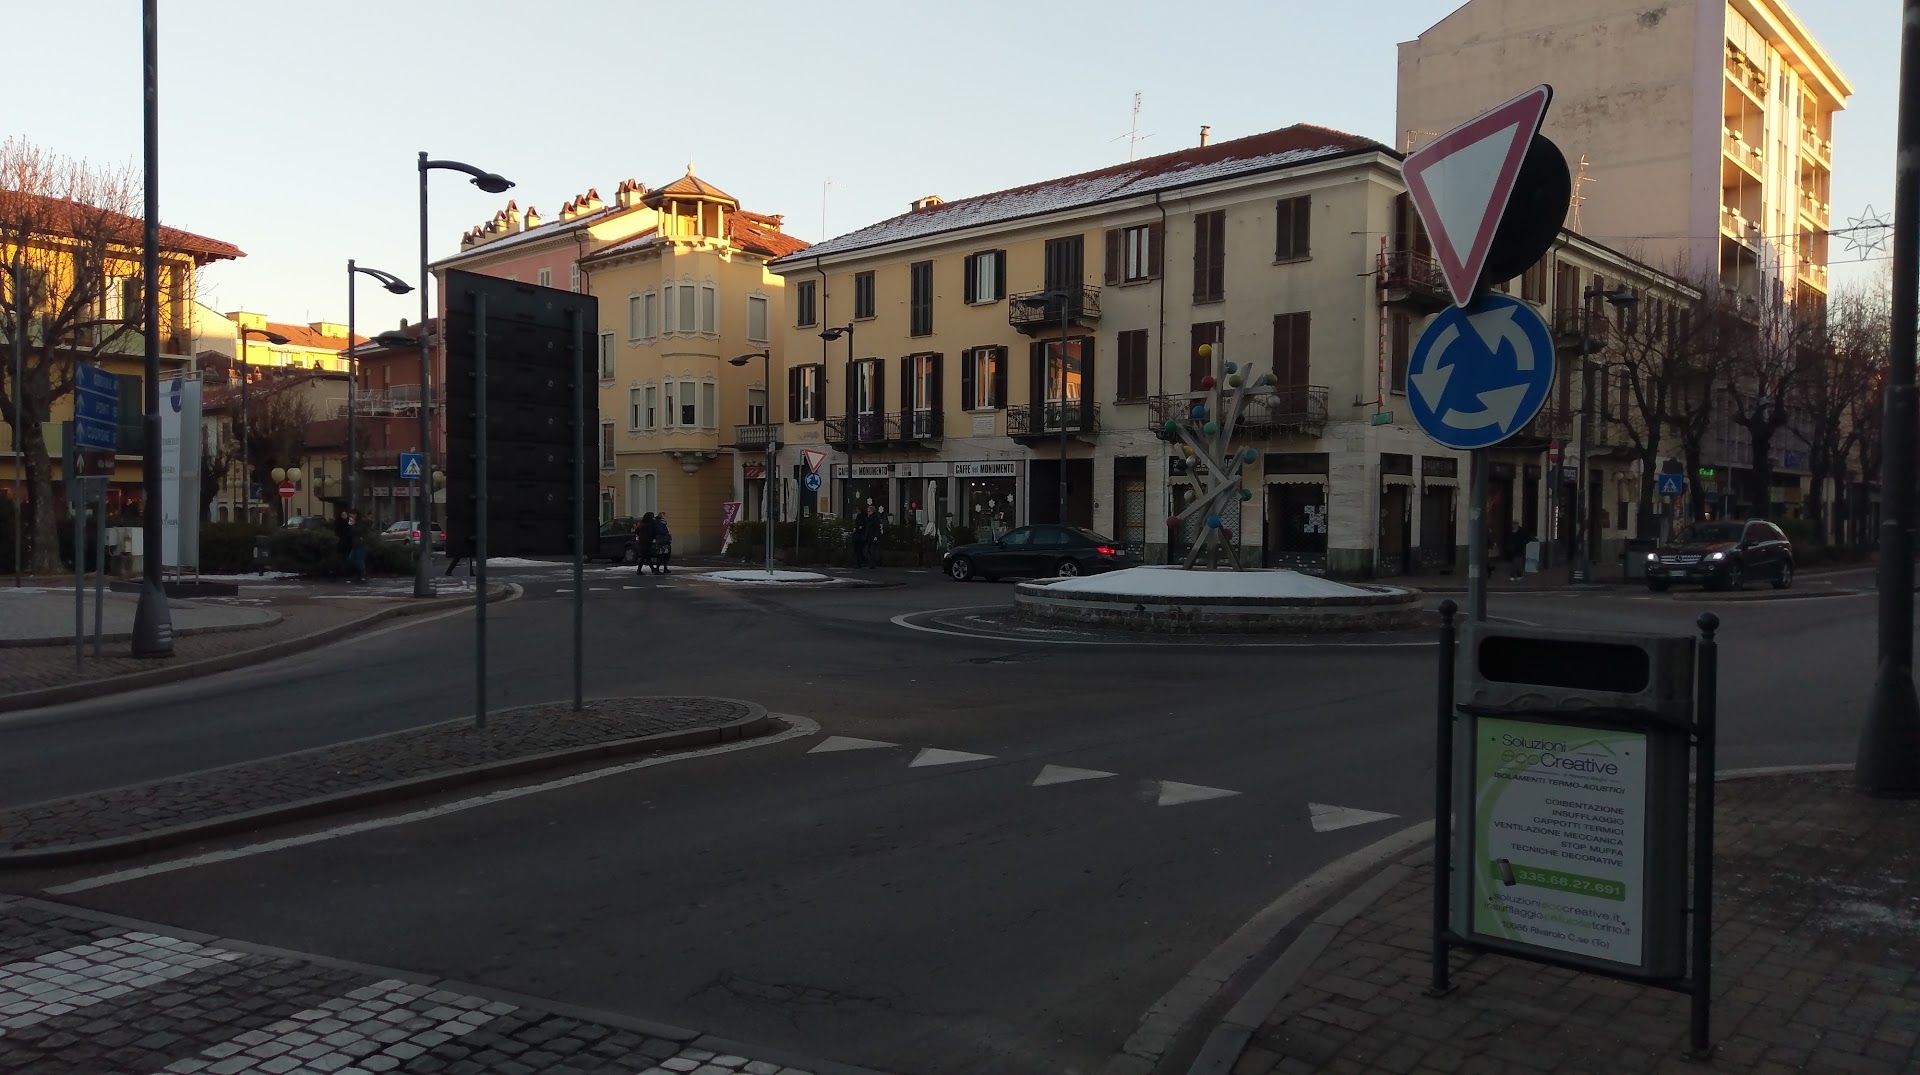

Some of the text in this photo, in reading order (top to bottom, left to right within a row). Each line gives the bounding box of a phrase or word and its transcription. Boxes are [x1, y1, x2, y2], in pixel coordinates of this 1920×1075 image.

[858, 467, 888, 476] MONUMENTO
[980, 463, 1014, 474] MONUMENTO
[1502, 733, 1566, 753] Soluzioni
[1494, 772, 1626, 795] ISOLAMENTI TERMO-ACUSTICI
[1545, 798, 1624, 815] COIBENTAZIONE
[1533, 817, 1624, 836] CAPPOTTI TERMICI
[1552, 810, 1624, 826] INSUFFLAGGIO
[1494, 821, 1624, 846] VENTILAZIONE MECCANICA
[1510, 843, 1623, 867] TECNICHE DECORATIVE
[1561, 842, 1624, 857] STOP MUFFA
[1519, 870, 1621, 896] 335.68.27.691
[1503, 920, 1529, 932] 10086
[1530, 926, 1566, 940] Rivarolo
[1591, 937, 1610, 949] (To)
